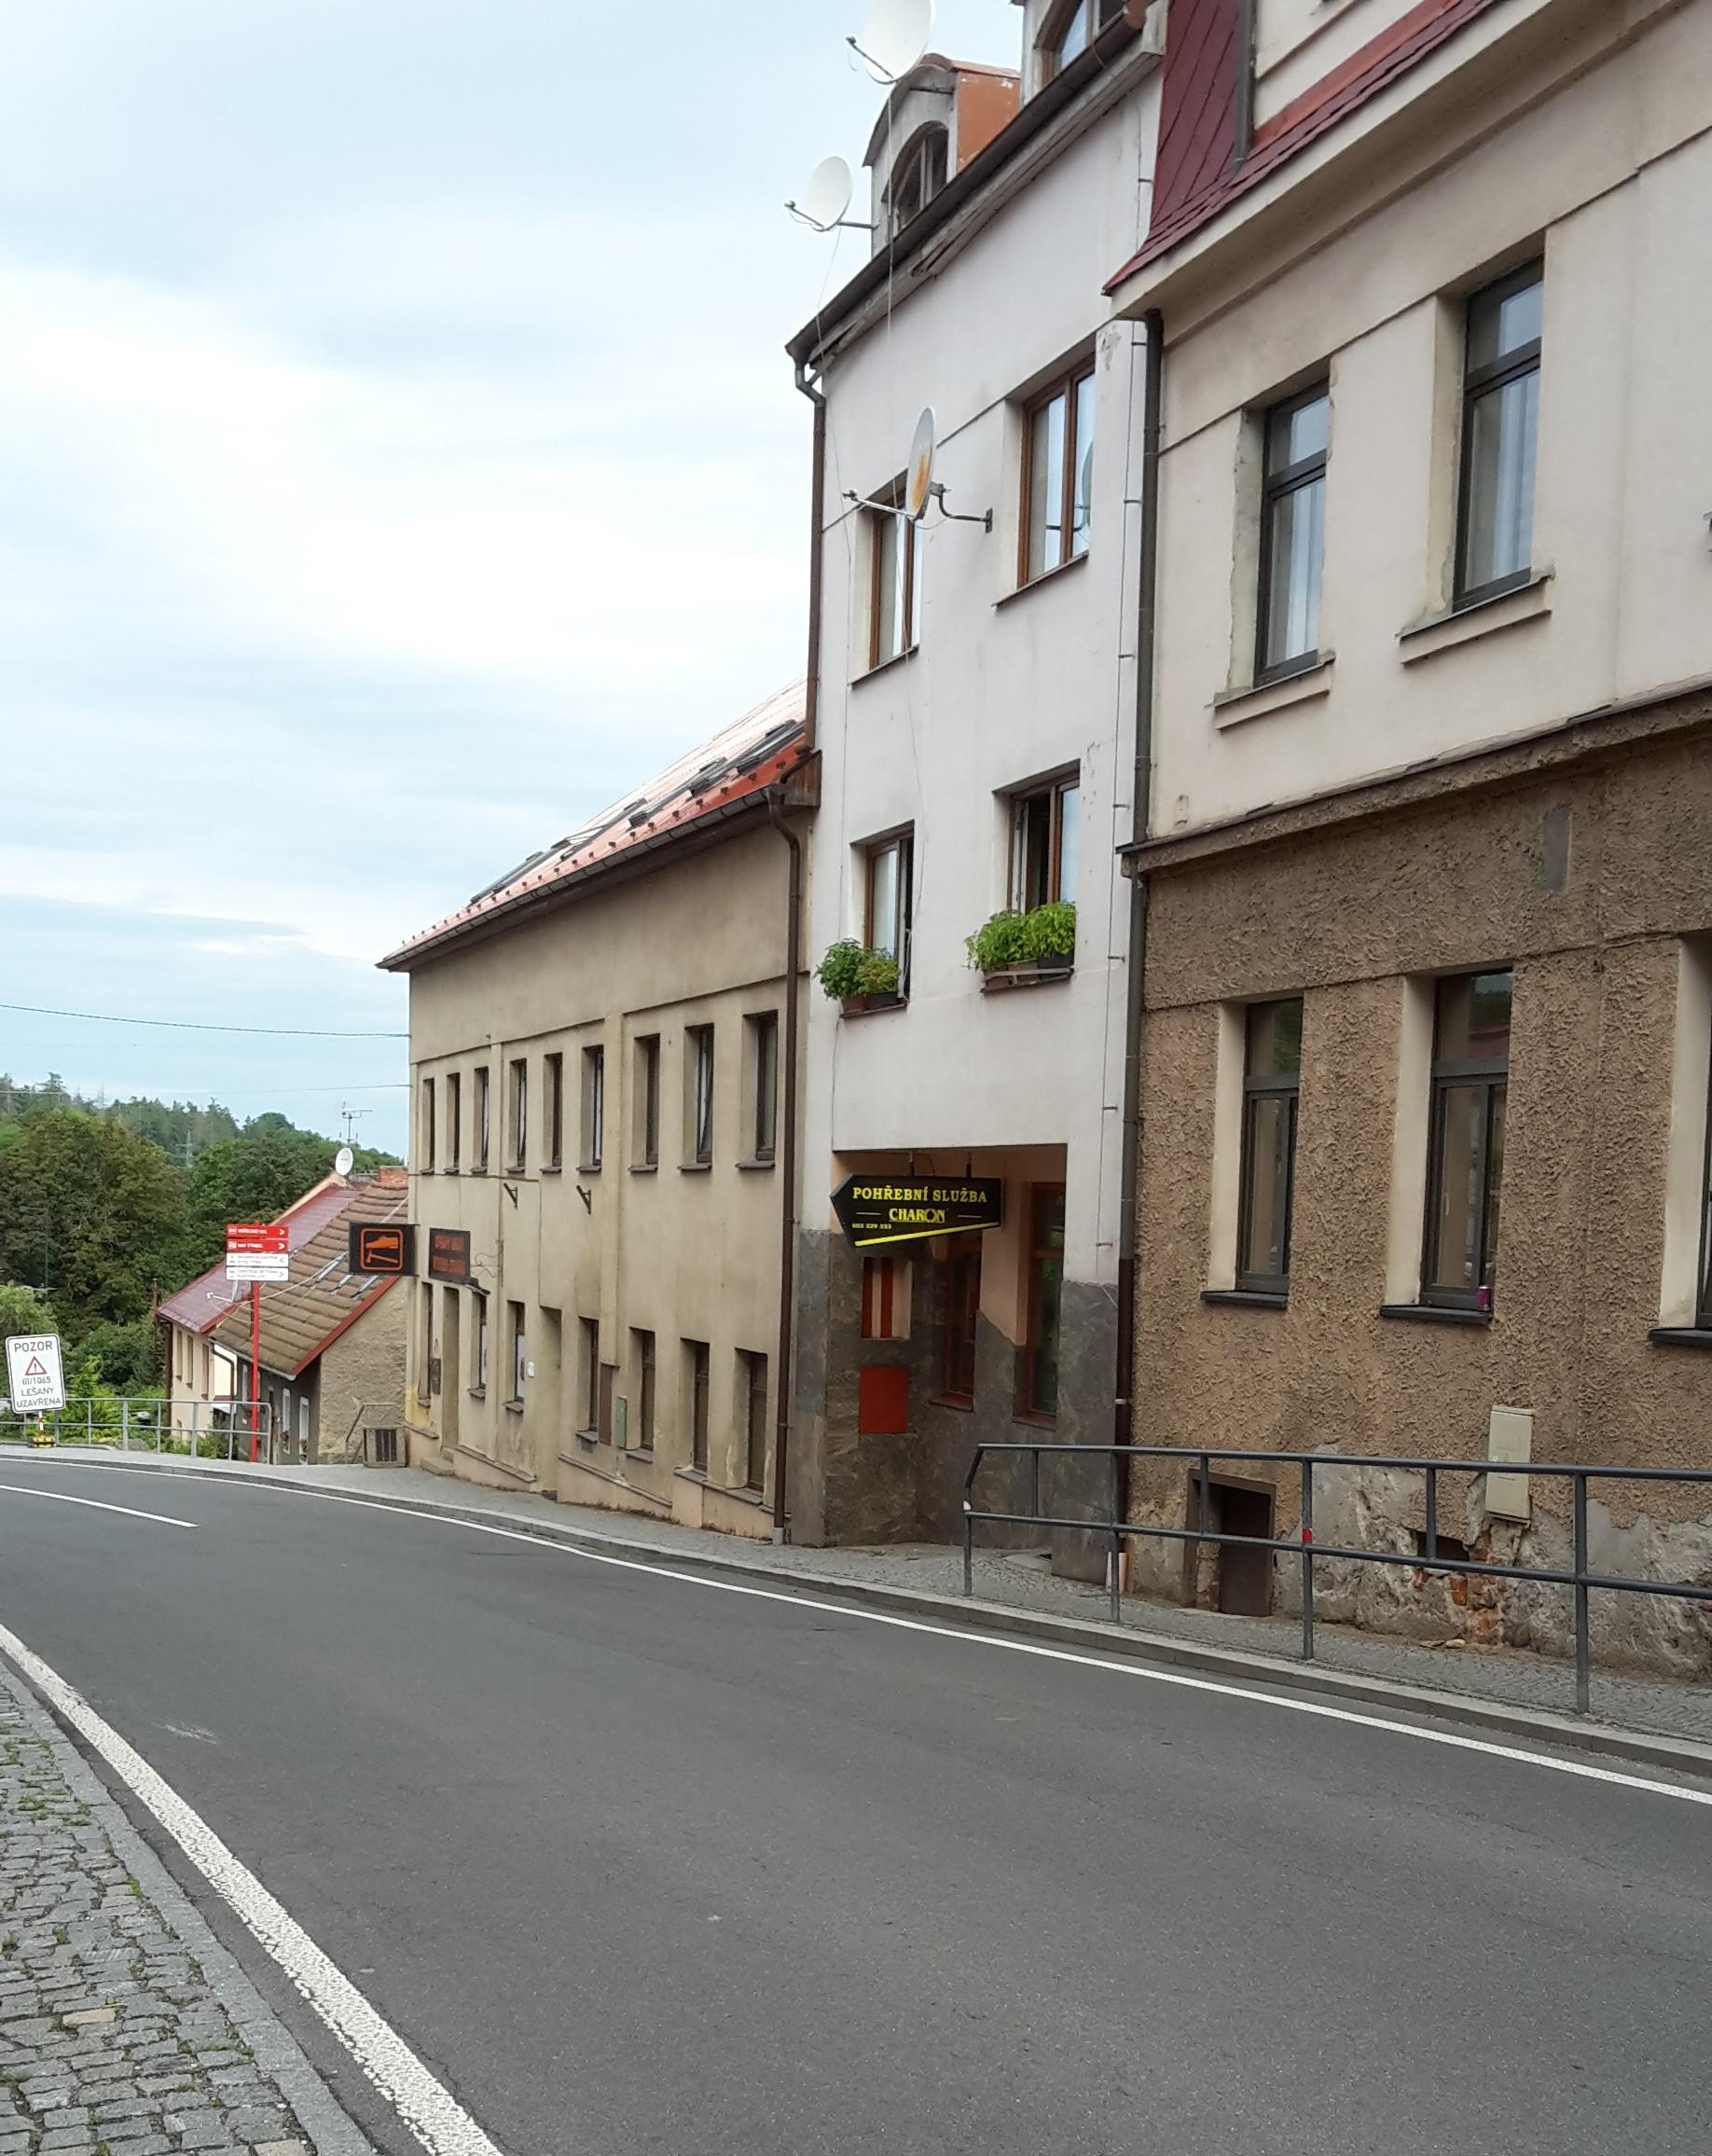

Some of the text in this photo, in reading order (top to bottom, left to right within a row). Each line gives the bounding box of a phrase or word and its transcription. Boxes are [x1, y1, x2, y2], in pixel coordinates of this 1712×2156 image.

[852, 1185, 987, 1203] POHŘEBNÍ SLUŽBA
[889, 1208, 946, 1223] CHARON
[14, 1340, 53, 1353] POZOR
[21, 1386, 54, 1397] LEŠANY
[17, 1397, 62, 1409] UZAVŘENA
